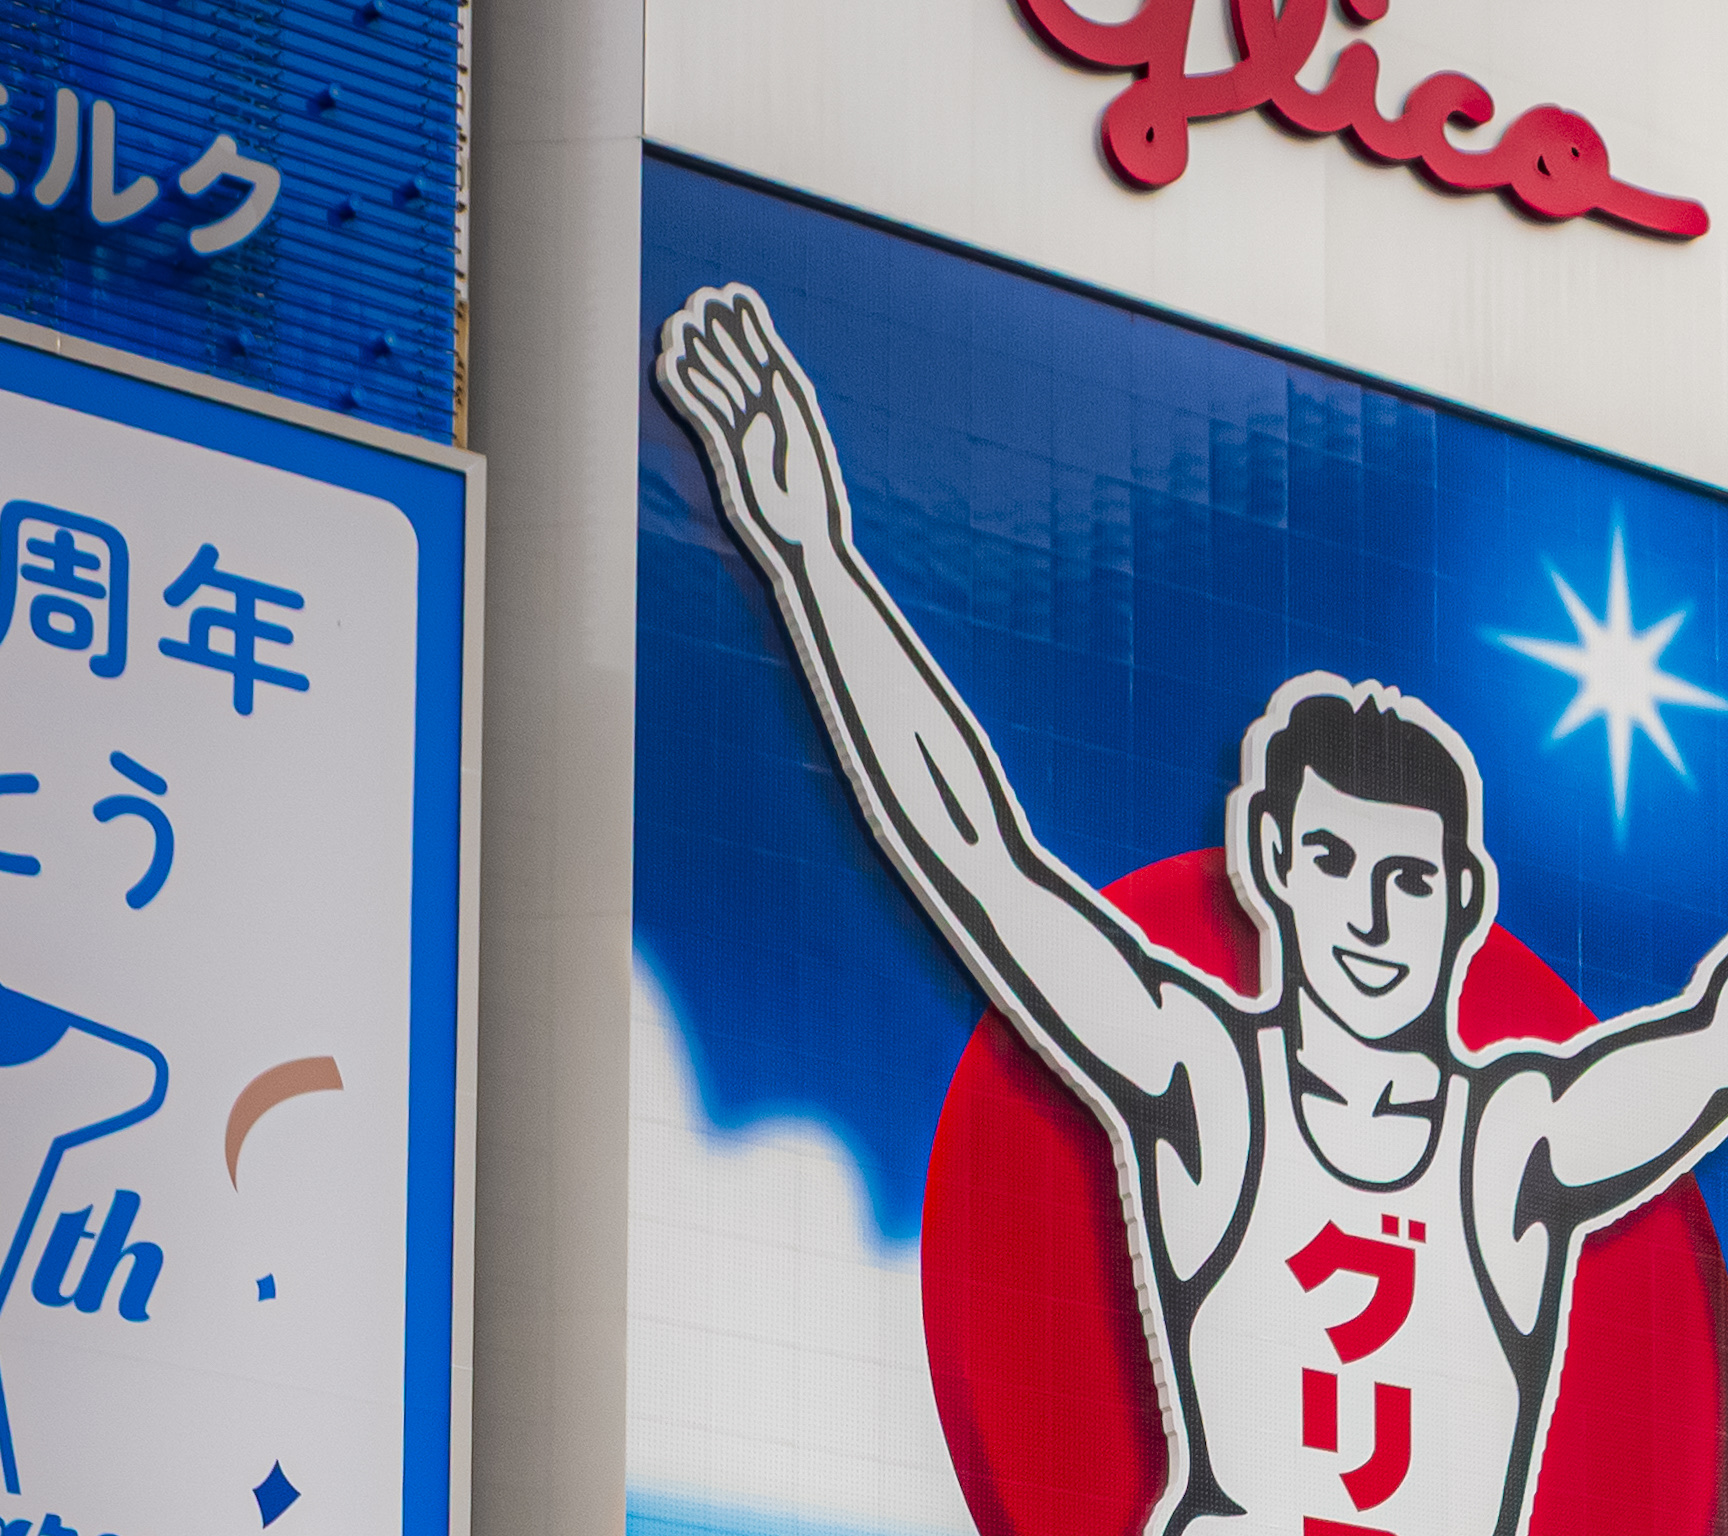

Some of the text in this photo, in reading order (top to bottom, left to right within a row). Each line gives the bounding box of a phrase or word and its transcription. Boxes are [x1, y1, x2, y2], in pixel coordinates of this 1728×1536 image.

[0, 83, 281, 254] ルク
[0, 499, 310, 716] 周年
[31, 1188, 165, 1322] th
